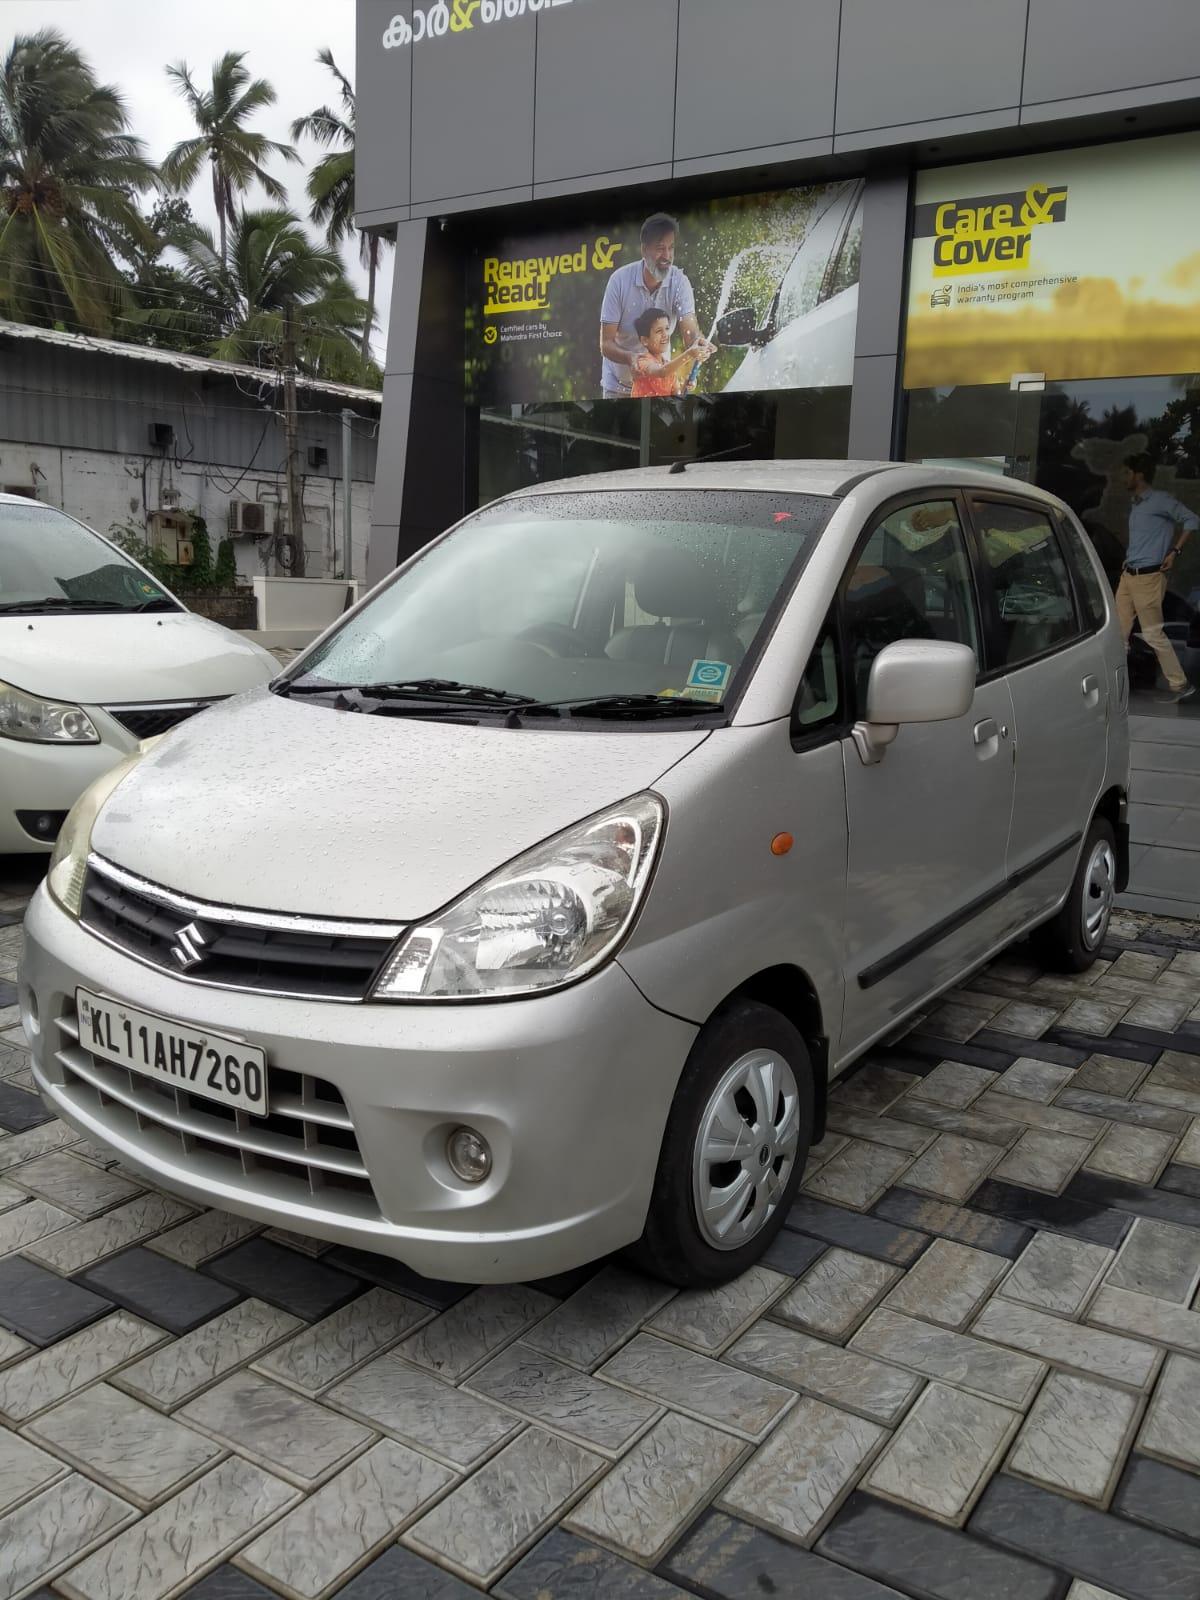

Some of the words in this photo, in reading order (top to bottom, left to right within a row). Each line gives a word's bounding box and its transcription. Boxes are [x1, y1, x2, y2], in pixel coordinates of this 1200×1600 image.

[935, 203, 1013, 236] Care
[1020, 183, 1068, 225] &
[485, 244, 587, 283] Renewed
[592, 236, 623, 270] &
[934, 233, 1032, 267] Cover
[487, 276, 550, 306] Ready
[957, 283, 985, 293] India's
[987, 282, 1009, 291] most
[1011, 276, 1077, 289] comprehensive
[957, 293, 995, 304] warranty
[998, 290, 1034, 302] program
[500, 333, 528, 341] Mahindra
[529, 332, 542, 340] First
[543, 330, 562, 338] Choice
[539, 322, 547, 331] by
[90, 1006, 262, 1102] KL11AH7260
